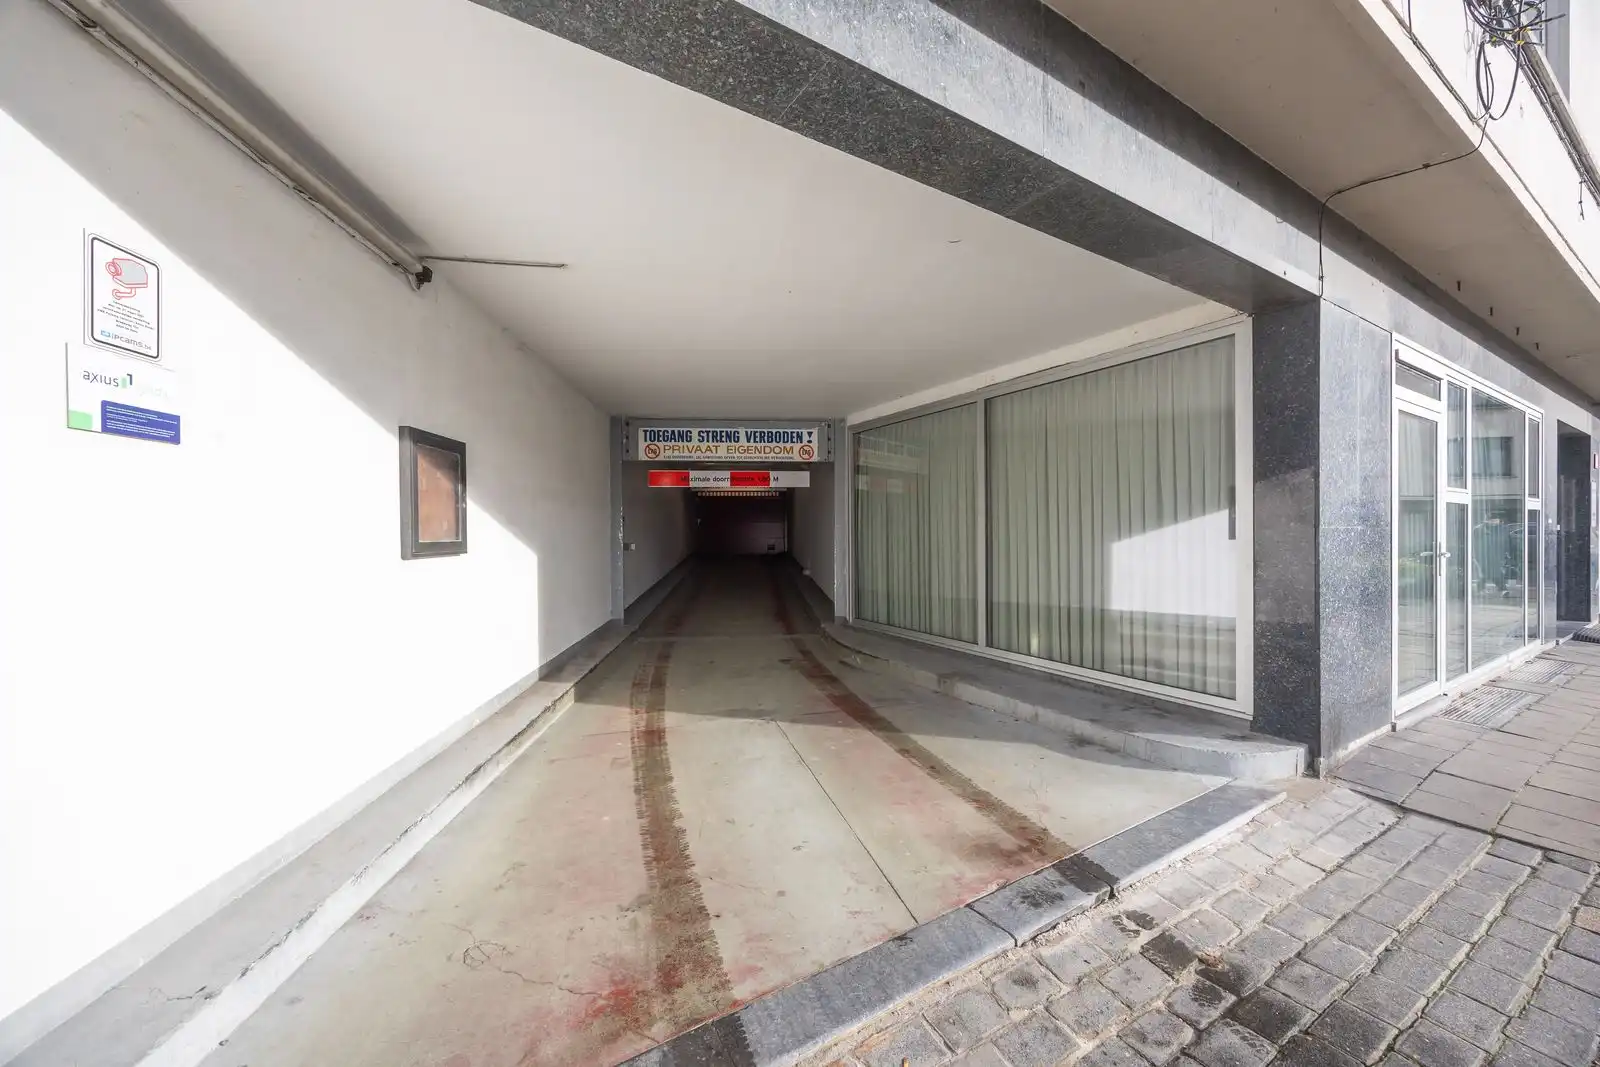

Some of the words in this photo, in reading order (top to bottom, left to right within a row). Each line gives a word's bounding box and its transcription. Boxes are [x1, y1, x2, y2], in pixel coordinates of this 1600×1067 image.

[643, 429, 693, 443] TOEGANG
[698, 430, 740, 443] STRENG
[745, 430, 803, 443] VERBODEN
[663, 444, 721, 454] PRIVAAT
[726, 445, 794, 455] EIGENDOM
